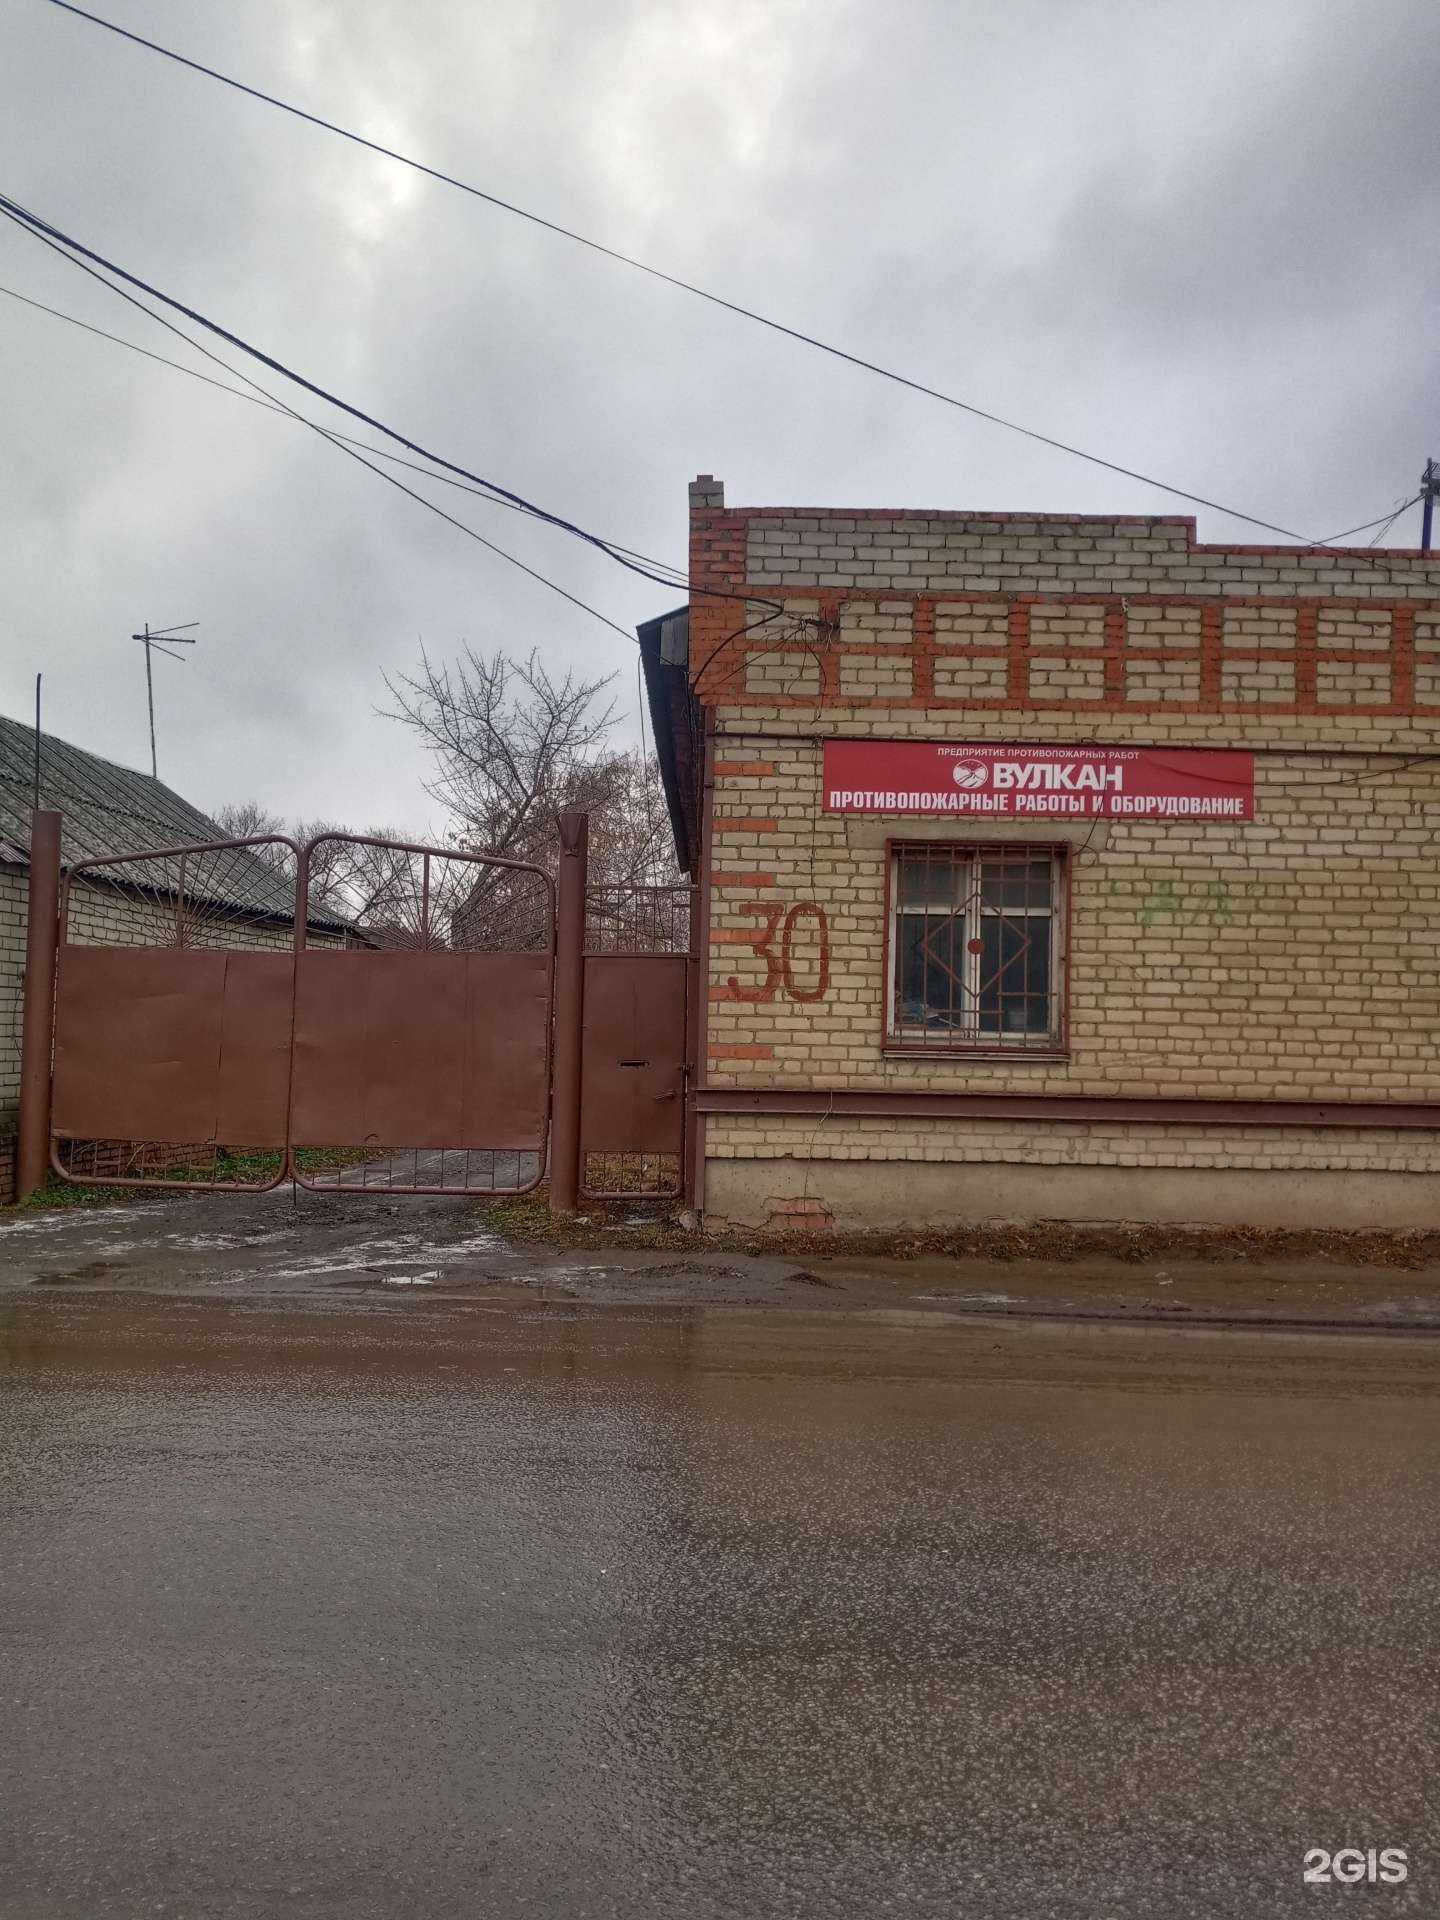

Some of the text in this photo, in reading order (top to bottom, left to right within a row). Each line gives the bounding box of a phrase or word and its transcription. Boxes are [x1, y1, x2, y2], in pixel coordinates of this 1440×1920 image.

[937, 747, 1140, 760] ПРЕДПРИЯТИЕ ПРОТИВОПОЖАРНЫХ РАБОТ
[993, 762, 1123, 791] ВУЛКАН
[829, 791, 1244, 816] ПРОТИВОПОЖАРНЫЕ РАБОТЫ И ОБОРУДОВАНИЕ
[727, 902, 830, 1004] 30
